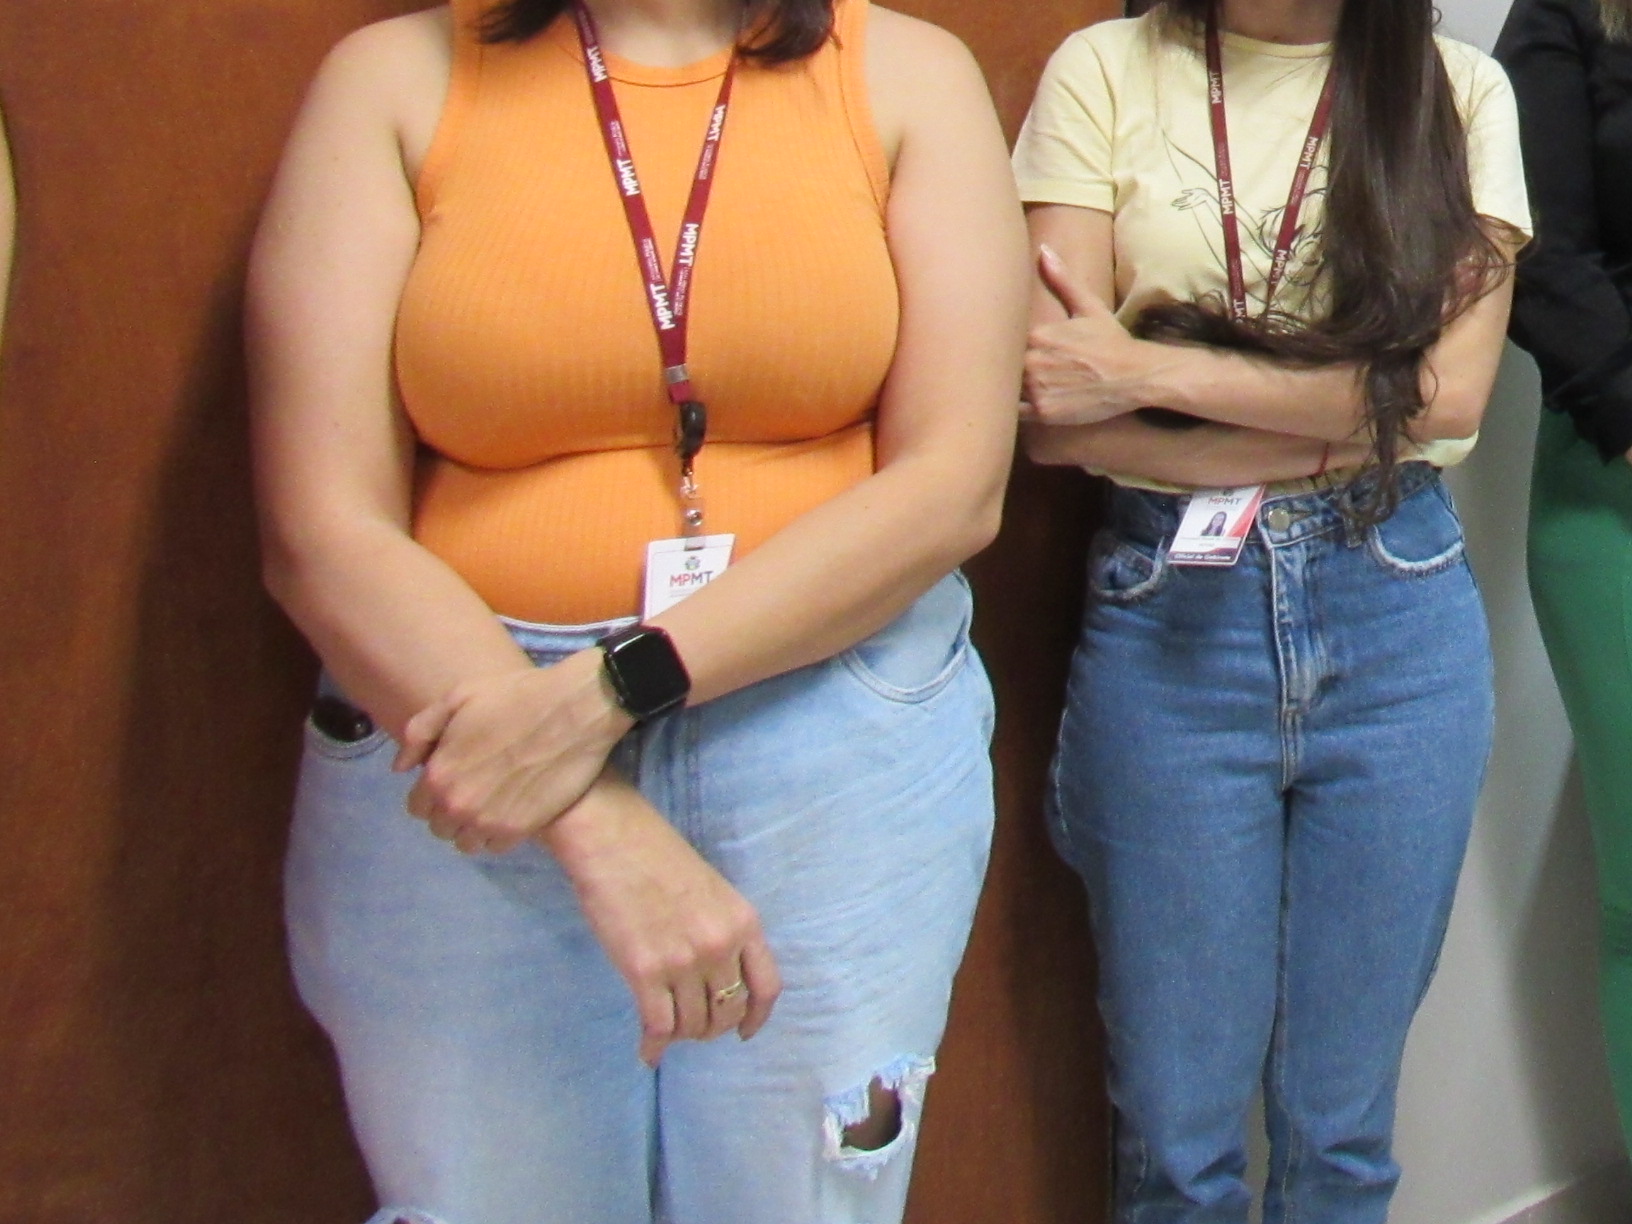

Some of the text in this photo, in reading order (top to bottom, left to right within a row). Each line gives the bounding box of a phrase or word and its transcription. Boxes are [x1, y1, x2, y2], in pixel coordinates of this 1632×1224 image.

[586, 45, 608, 83] MPMT
[1209, 72, 1222, 104] MPMT
[706, 104, 726, 142] MPMT
[1299, 136, 1319, 170] MPMT
[616, 158, 641, 196] MPMT
[1218, 178, 1234, 215] MPMT
[678, 222, 700, 267] MPMT
[650, 283, 676, 331] MPMT
[1208, 497, 1242, 506] MPMT
[669, 570, 714, 588] MPMT
